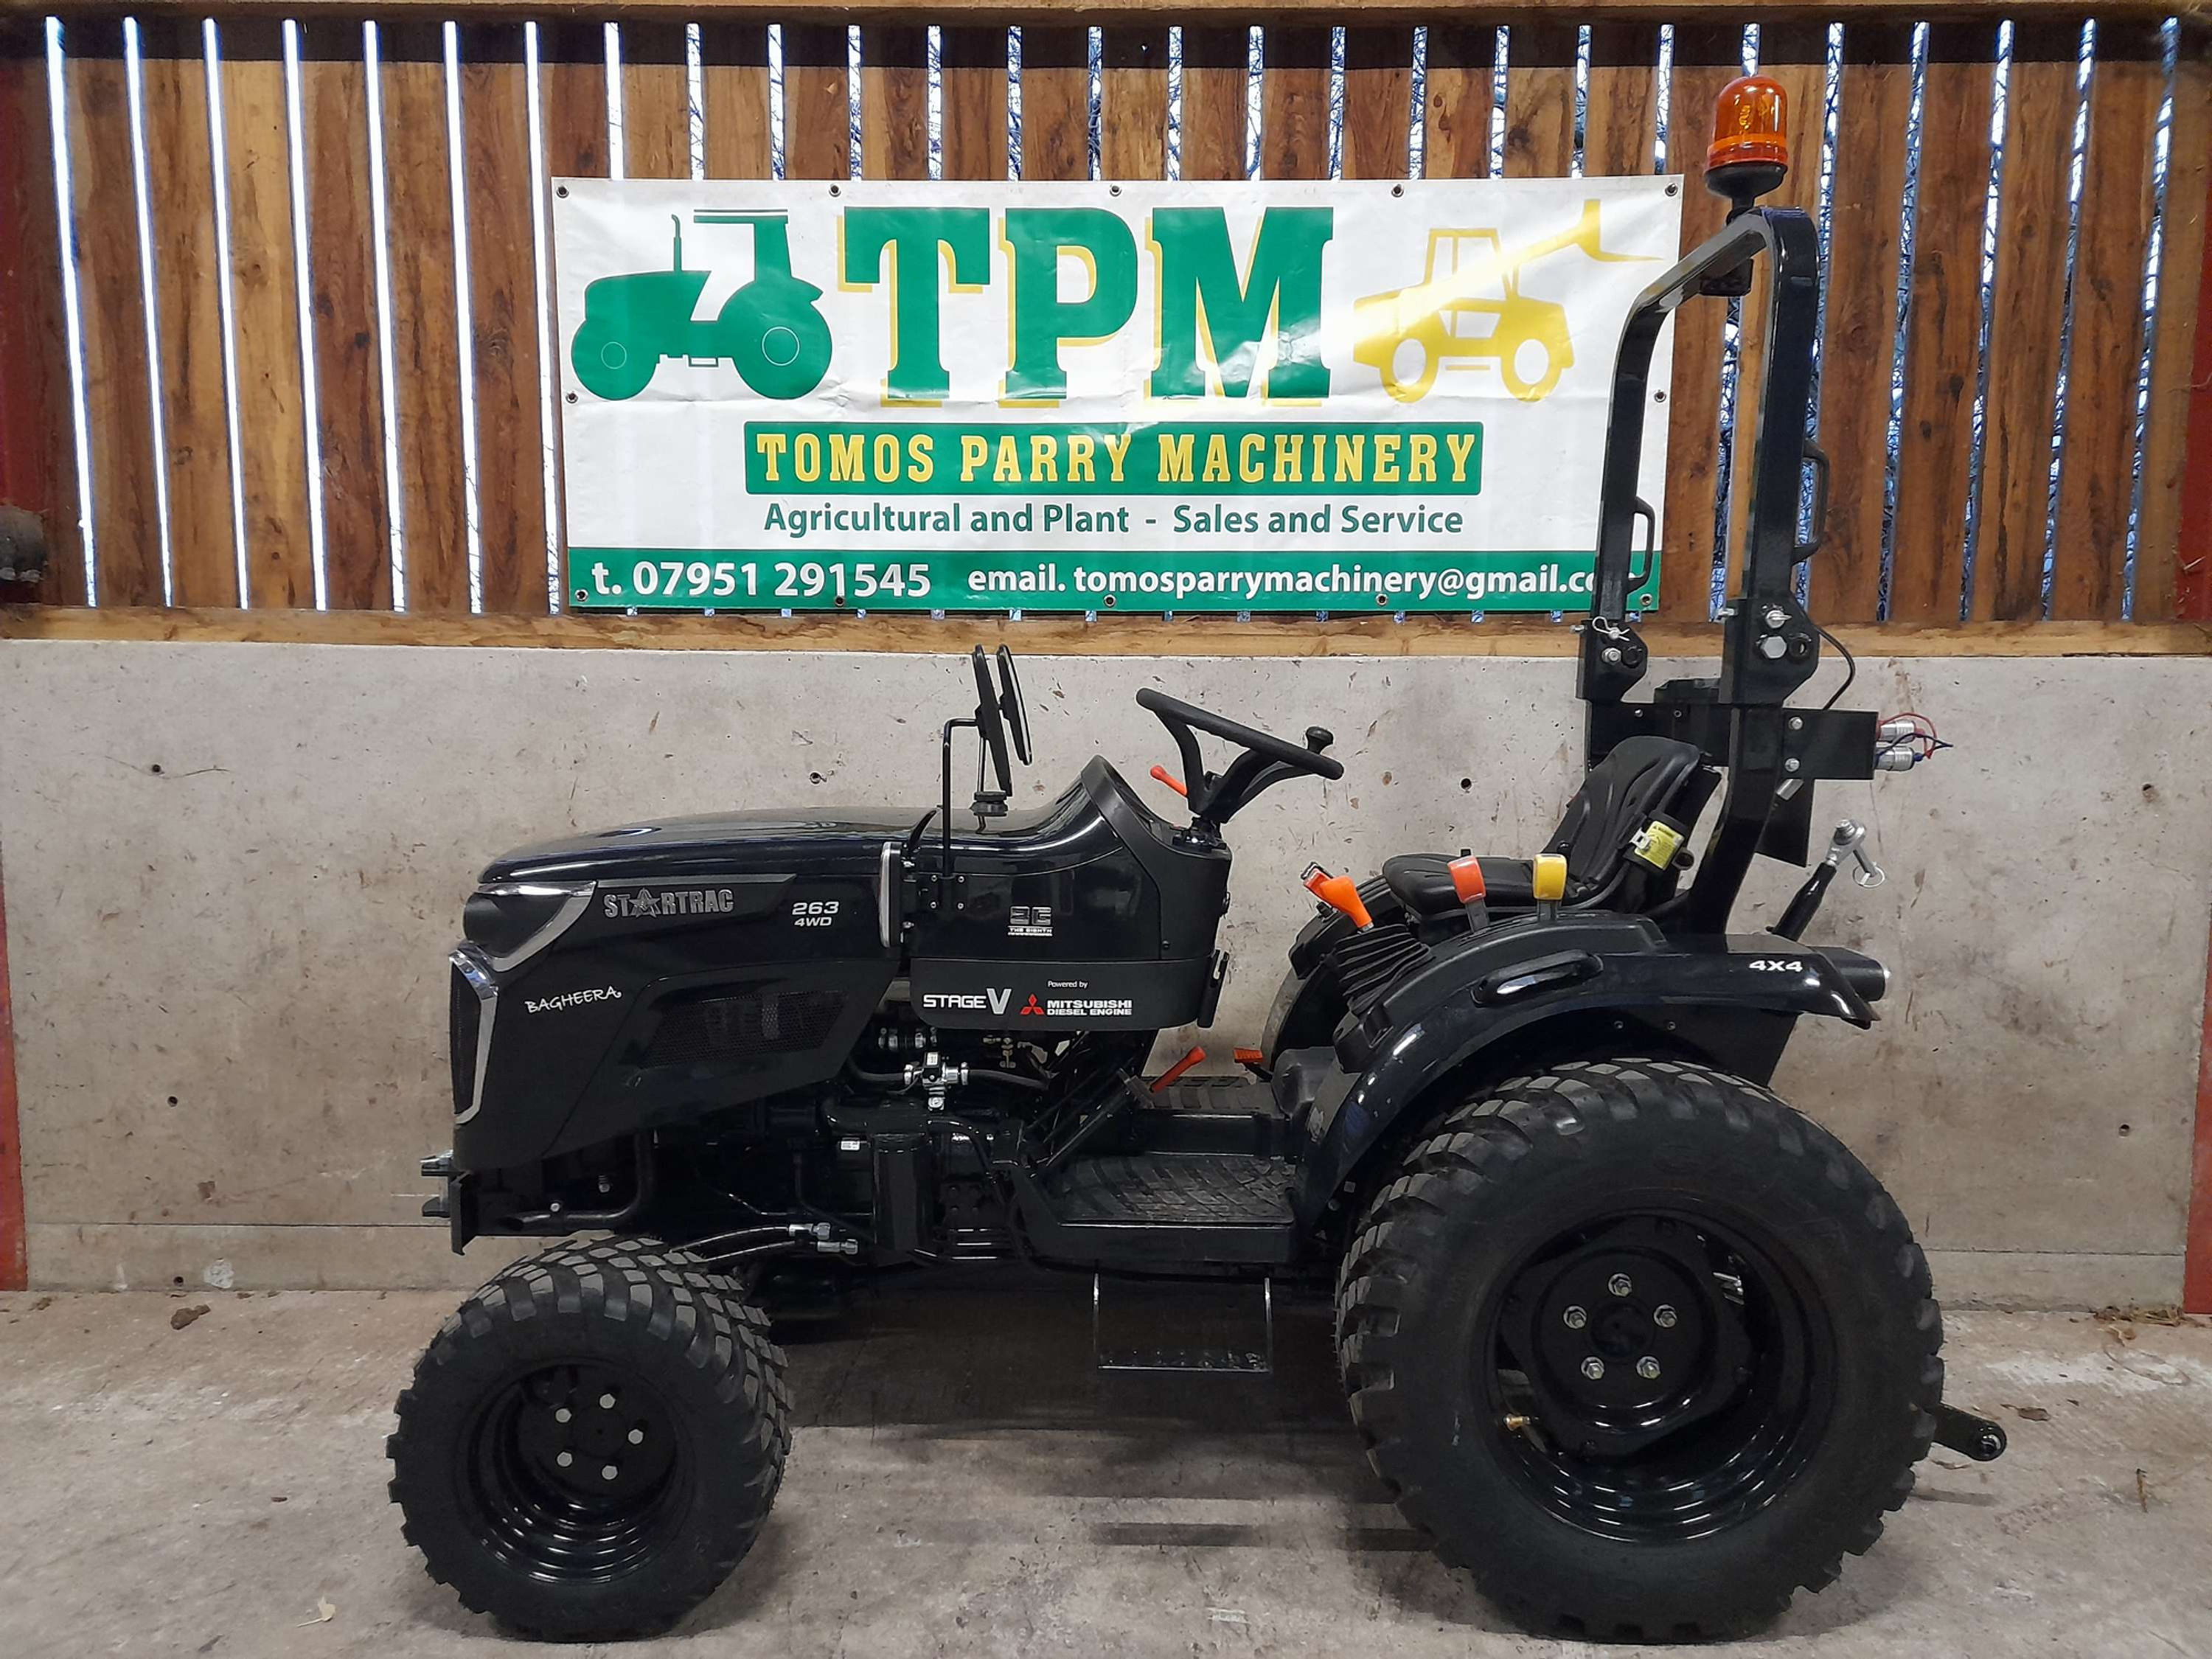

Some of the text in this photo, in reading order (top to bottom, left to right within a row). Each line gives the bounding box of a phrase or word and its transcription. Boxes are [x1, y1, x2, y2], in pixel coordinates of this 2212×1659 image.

[838, 206, 1334, 408] TPM
[757, 434, 1475, 483] TOMOS PARRY MACHINERY
[764, 503, 959, 538] Agricultural
[971, 504, 1032, 532] and
[1044, 504, 1130, 533] Plant
[1174, 504, 1259, 534] Sales
[1268, 505, 1330, 534] and
[1341, 505, 1464, 535] Service
[592, 562, 931, 597] t. 07951 291545
[968, 563, 1635, 599] email. tomosparrymachinery@gmail.c
[603, 887, 734, 919] STARTRAC
[792, 901, 838, 916] 263
[794, 917, 832, 927] 4WD
[1749, 960, 1803, 973] 4X4
[1079, 981, 1088, 989] by
[524, 986, 622, 1015] BAGHEERA
[923, 988, 1012, 1015] STAGE V
[1047, 1000, 1132, 1009] MITSUBISHI
